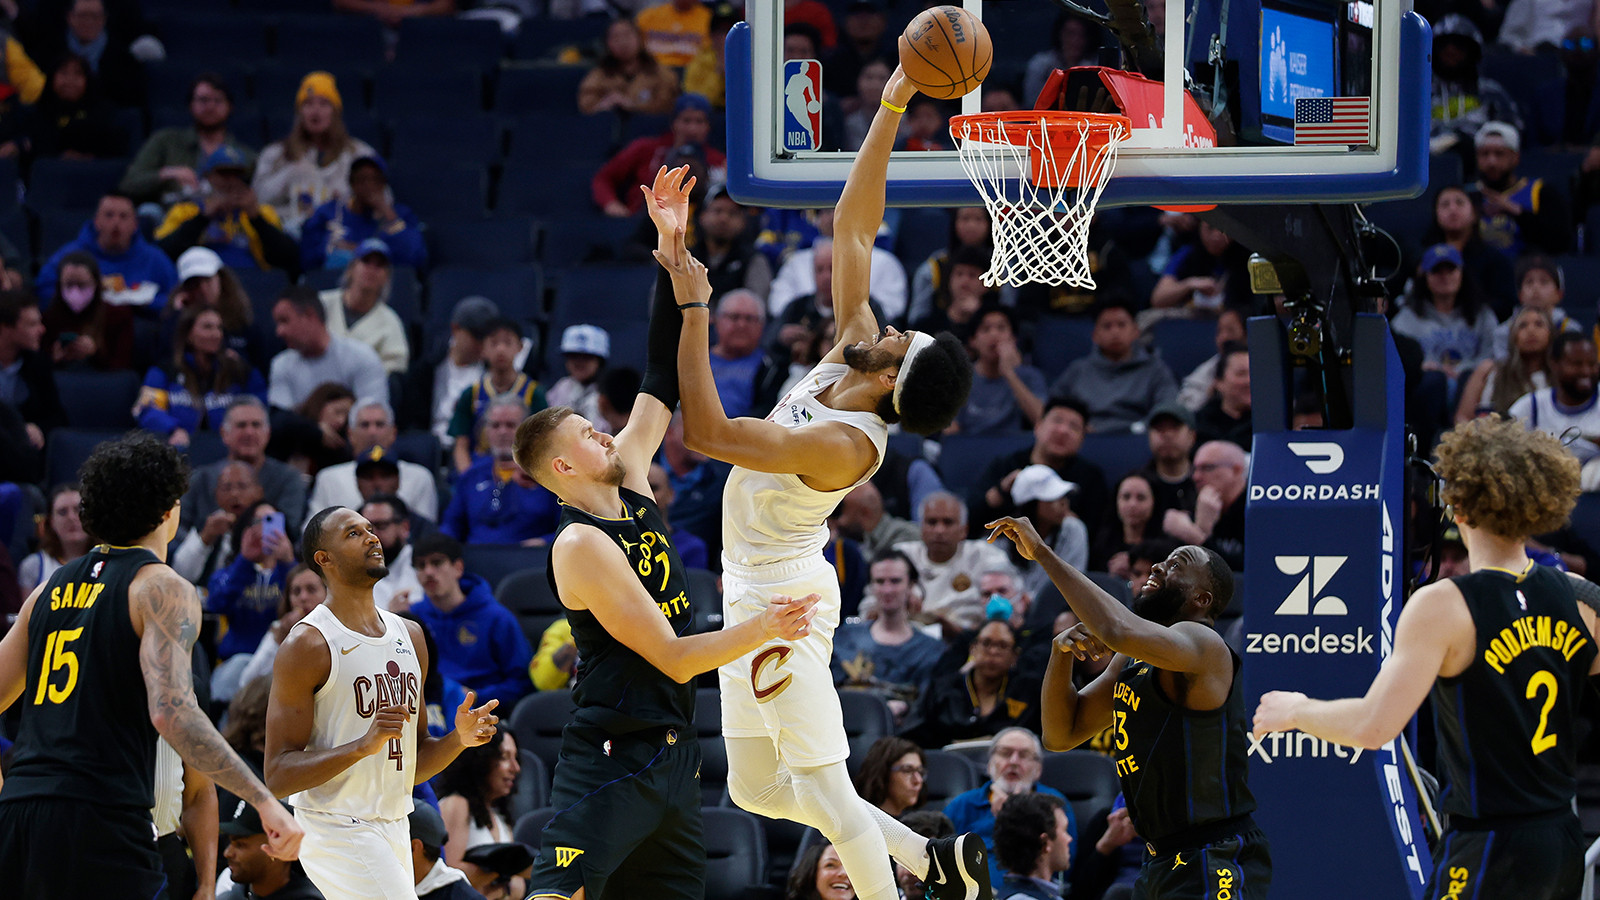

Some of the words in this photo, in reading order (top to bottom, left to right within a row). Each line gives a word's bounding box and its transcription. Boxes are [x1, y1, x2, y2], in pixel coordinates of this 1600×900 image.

[787, 131, 807, 146] NBA
[1250, 484, 1380, 500] DOORDASH
[654, 551, 671, 592] 7
[1245, 626, 1374, 654] zendesk
[1484, 615, 1588, 675] PODZIEMSKI
[33, 626, 85, 705] 15
[353, 672, 419, 719] CAVS
[1526, 670, 1559, 757] 2
[387, 737, 403, 771] 4
